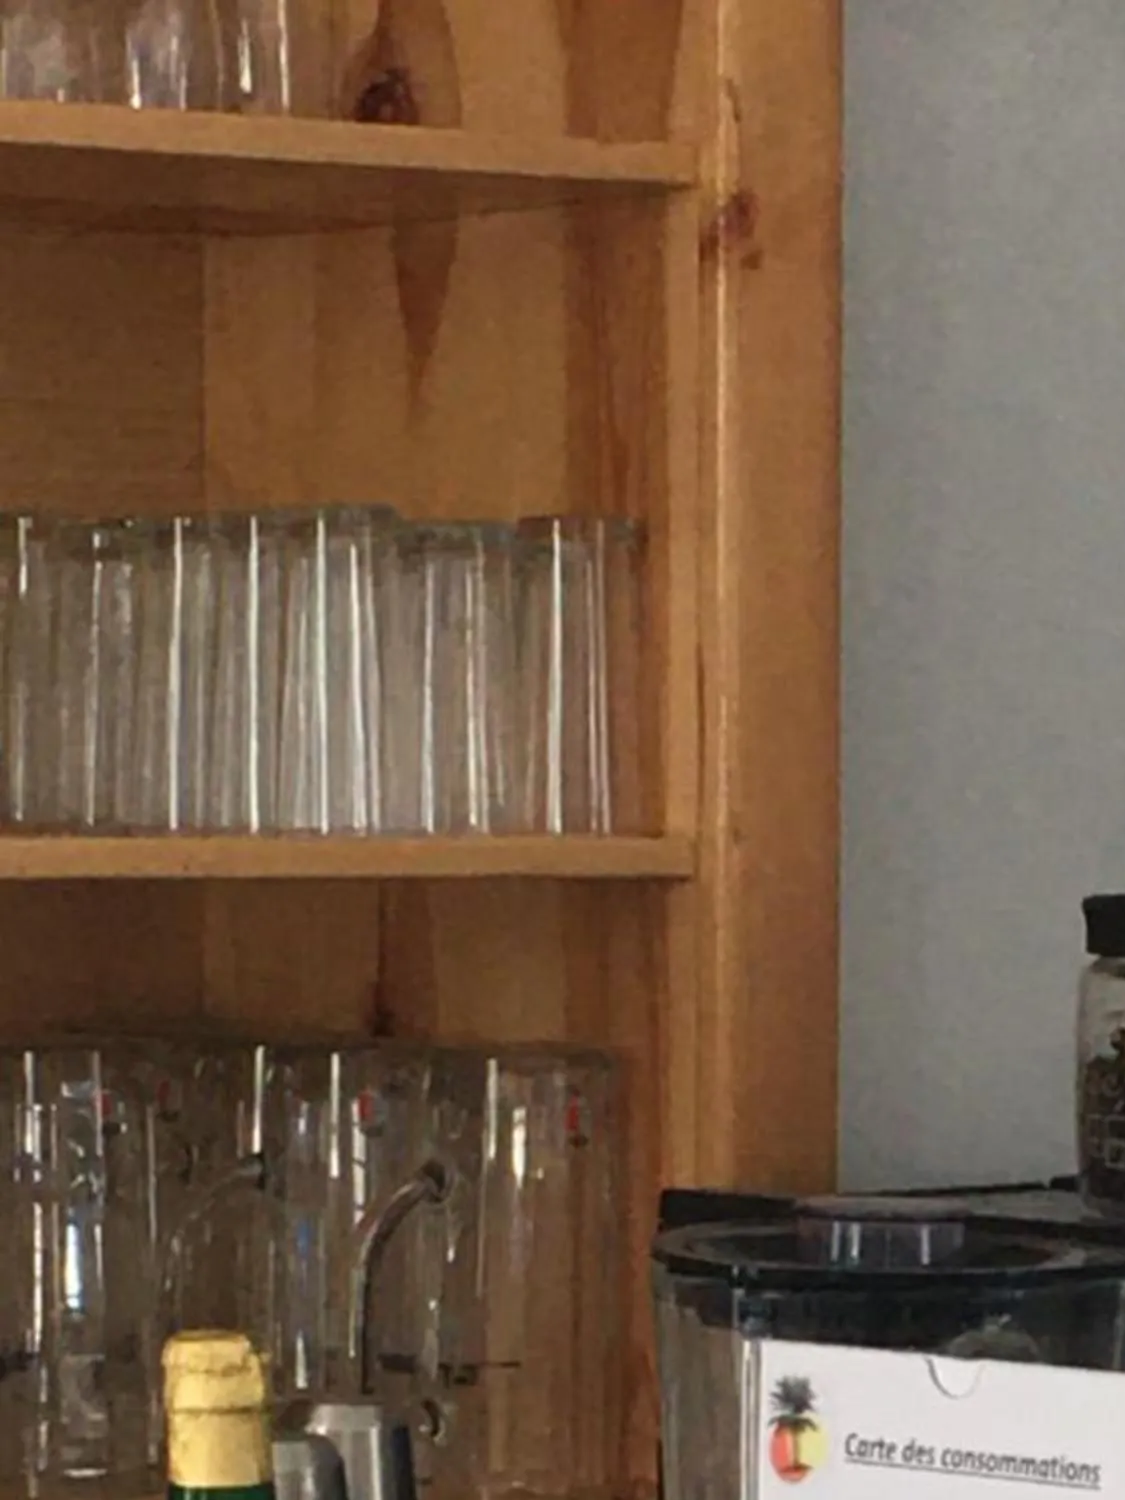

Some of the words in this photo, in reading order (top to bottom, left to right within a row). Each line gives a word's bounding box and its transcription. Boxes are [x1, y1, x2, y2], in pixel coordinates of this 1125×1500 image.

[844, 1432, 896, 1462] Carte
[901, 1438, 935, 1466] des
[940, 1447, 1101, 1483] consommations
